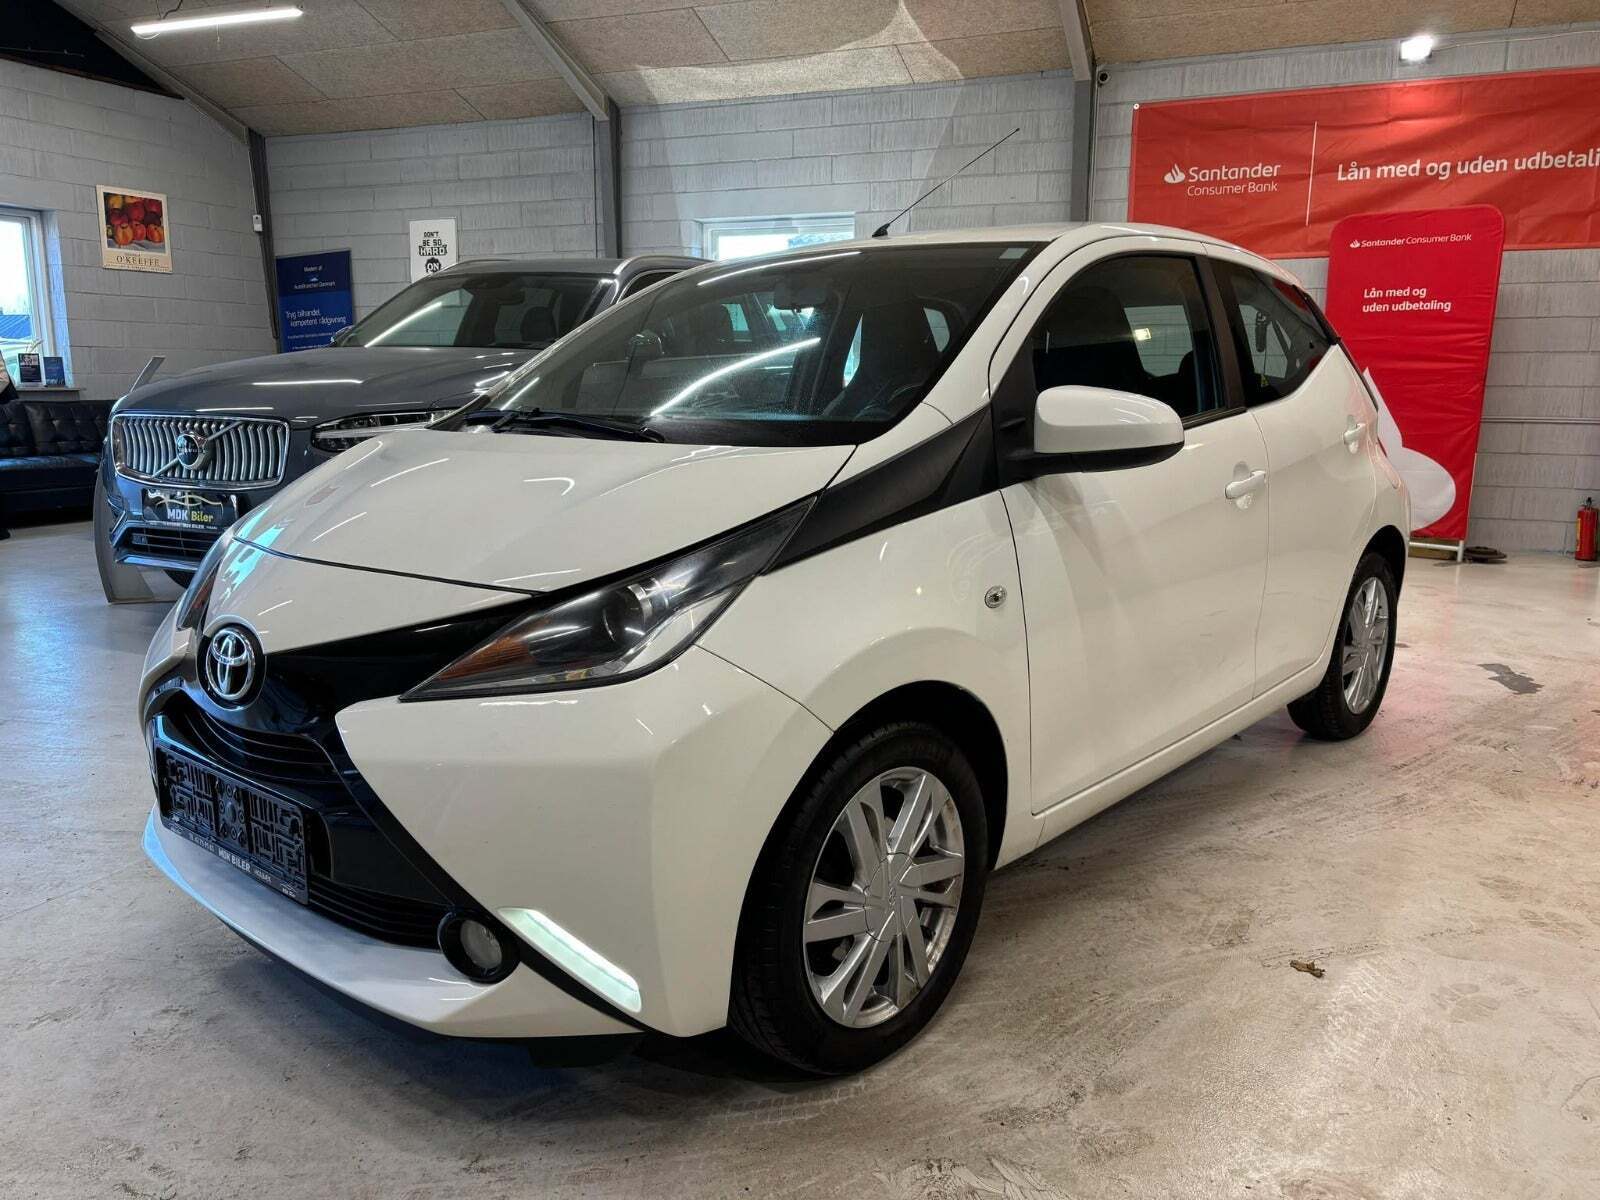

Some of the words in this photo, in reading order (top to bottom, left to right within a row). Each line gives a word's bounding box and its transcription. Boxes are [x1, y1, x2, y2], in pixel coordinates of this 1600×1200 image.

[1188, 162, 1281, 182] Santander
[1337, 161, 1371, 181] Lån
[1376, 159, 1421, 178] med
[1426, 161, 1451, 180] og
[1457, 155, 1508, 174] uden
[1187, 183, 1246, 197] Consumer
[1248, 181, 1278, 193] Bank
[422, 239, 431, 247] BE
[432, 238, 442, 246] SO
[1361, 238, 1405, 248] Santander
[1406, 235, 1450, 245] Consumer
[1450, 233, 1472, 242] Bank
[419, 245, 447, 256] HARD
[1363, 287, 1383, 298] Lån
[1386, 286, 1410, 298] med
[1412, 287, 1427, 298] og
[1362, 302, 1389, 313] uden
[1392, 300, 1452, 312] udbetaling
[167, 508, 188, 520] MDK
[191, 510, 214, 522] Biler
